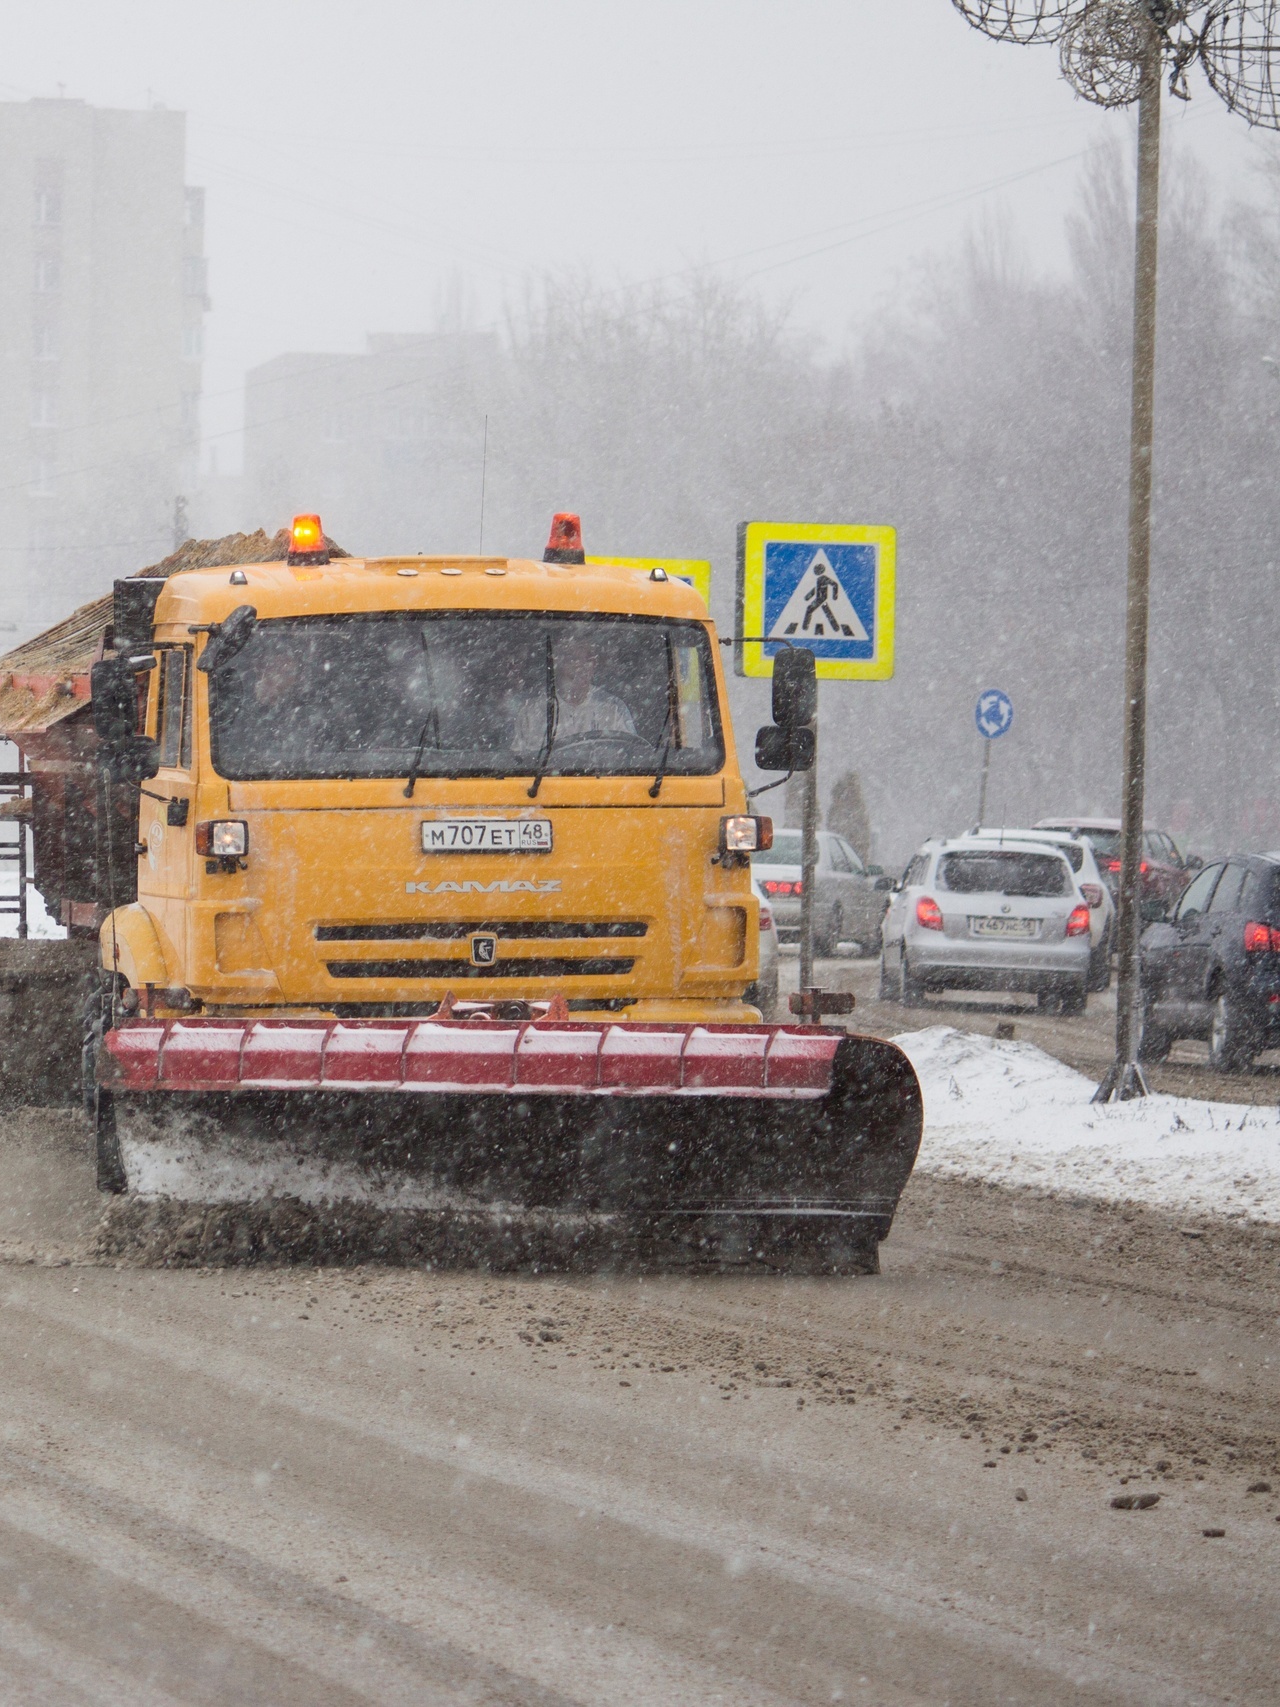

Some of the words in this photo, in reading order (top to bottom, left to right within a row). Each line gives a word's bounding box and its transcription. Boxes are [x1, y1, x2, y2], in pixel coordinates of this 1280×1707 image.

[431, 825, 515, 845] M707ET
[522, 823, 543, 839] 48
[405, 880, 562, 894] KAMAZ
